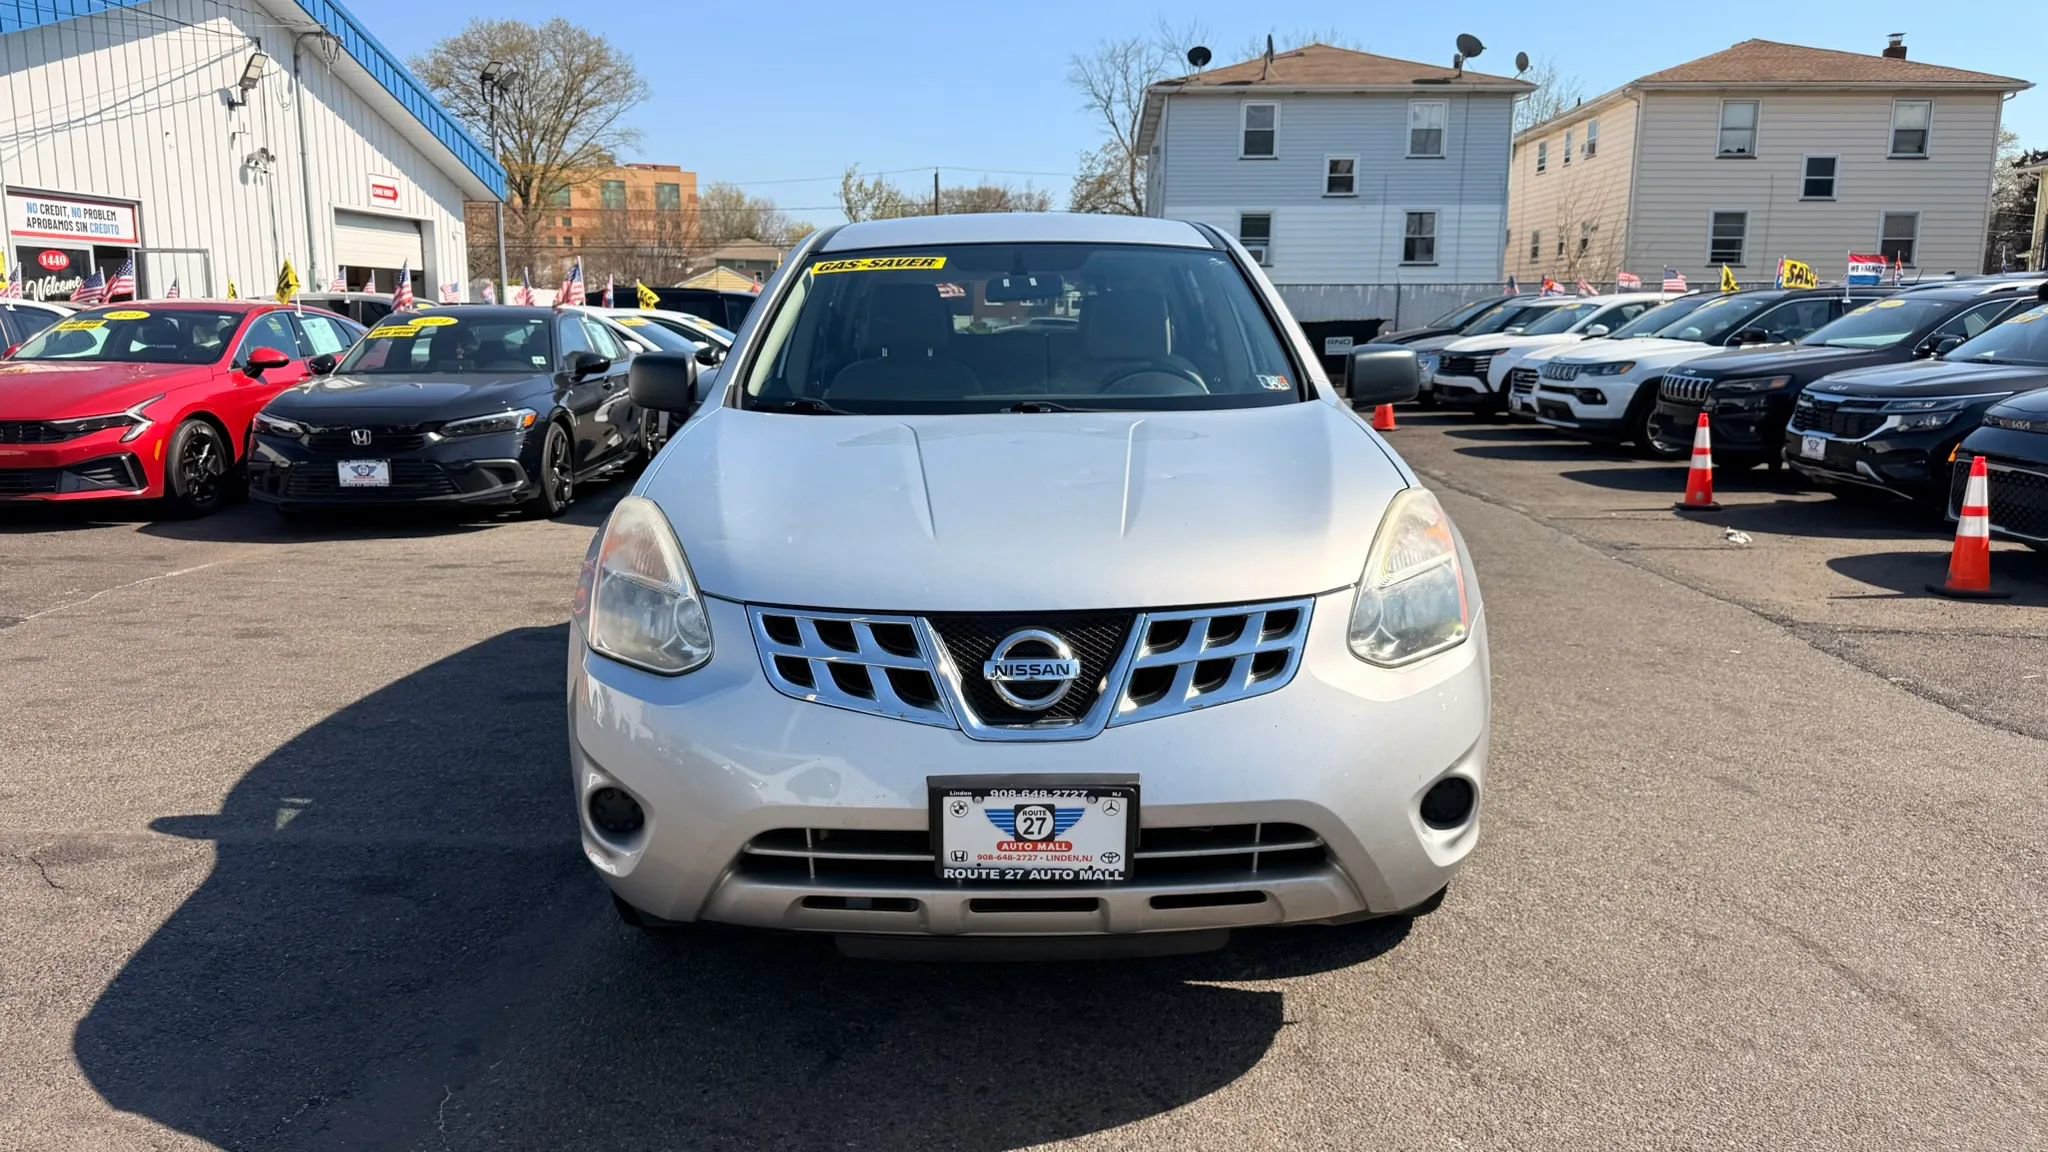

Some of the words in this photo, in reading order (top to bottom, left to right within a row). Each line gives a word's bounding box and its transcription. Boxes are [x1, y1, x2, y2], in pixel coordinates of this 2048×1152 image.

[26, 202, 38, 214] NO
[40, 203, 70, 219] CREDIT,
[71, 206, 82, 218] NO
[83, 208, 117, 221] PROBLEM
[26, 216, 74, 232] APROBAMOS
[75, 220, 88, 233] SIN
[41, 254, 67, 266] 1440
[819, 258, 937, 272] GAS-SAVER
[26, 275, 83, 301] Welcome
[994, 663, 1070, 676] NISSAN
[990, 789, 1088, 798] 908-648-2727
[1022, 809, 1047, 817] ROUTE
[1023, 817, 1047, 835] 27
[1001, 842, 1033, 851] AUTO
[1037, 842, 1068, 851] MALL
[977, 854, 1038, 862] 908-648-2727
[943, 868, 1000, 880] ROUTE
[1005, 869, 1025, 880] 27
[1029, 869, 1075, 881] AUTO
[1079, 869, 1124, 881] MALL
